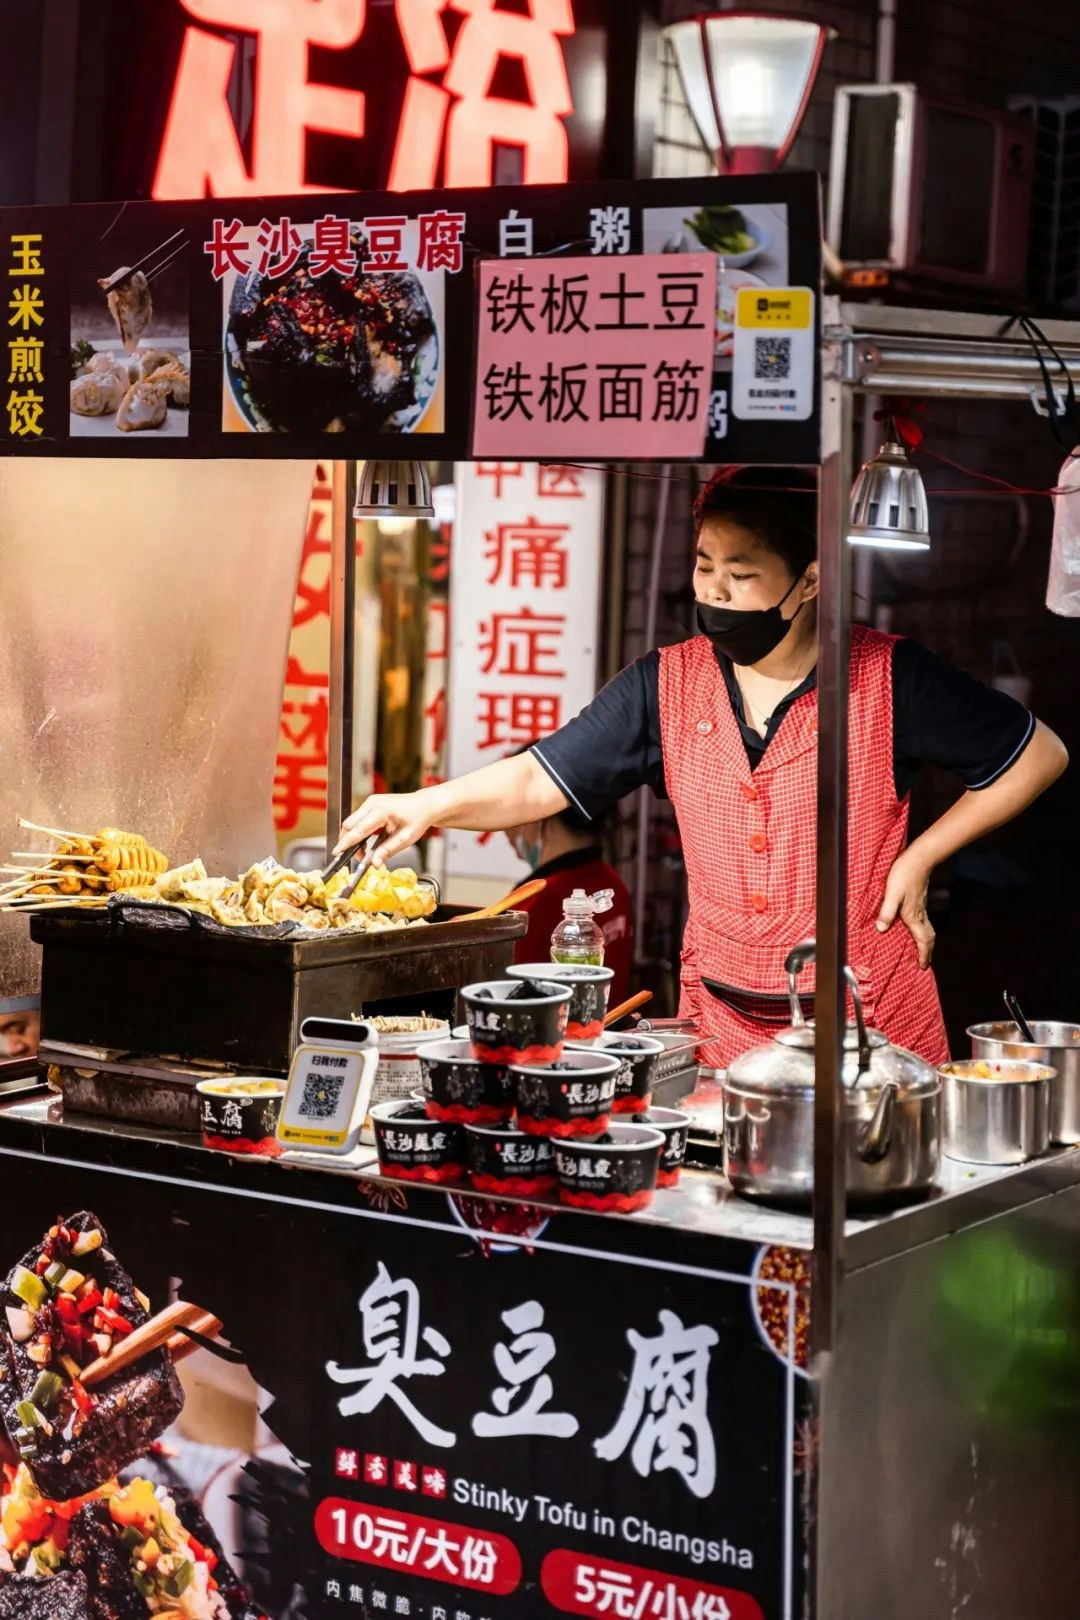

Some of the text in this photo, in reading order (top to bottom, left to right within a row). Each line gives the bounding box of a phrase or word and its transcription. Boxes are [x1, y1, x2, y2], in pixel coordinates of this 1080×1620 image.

[203, 210, 467, 281] 长沙臭豆腐
[6, 233, 46, 438] 玉米煎饺
[486, 272, 706, 335] 铁板土豆
[483, 359, 705, 423] 铁板面筋
[475, 462, 585, 499] 中医
[476, 515, 572, 845] 痛症理
[311, 1055, 348, 1068] 扫我付款
[325, 1260, 719, 1499] 臭豆腐
[336, 1450, 447, 1496] 鲜香美味
[331, 1508, 498, 1584] 10元/大份
[453, 1478, 754, 1569] Stinky Tofu in Changsha
[575, 1564, 731, 1620] 5元/小份
